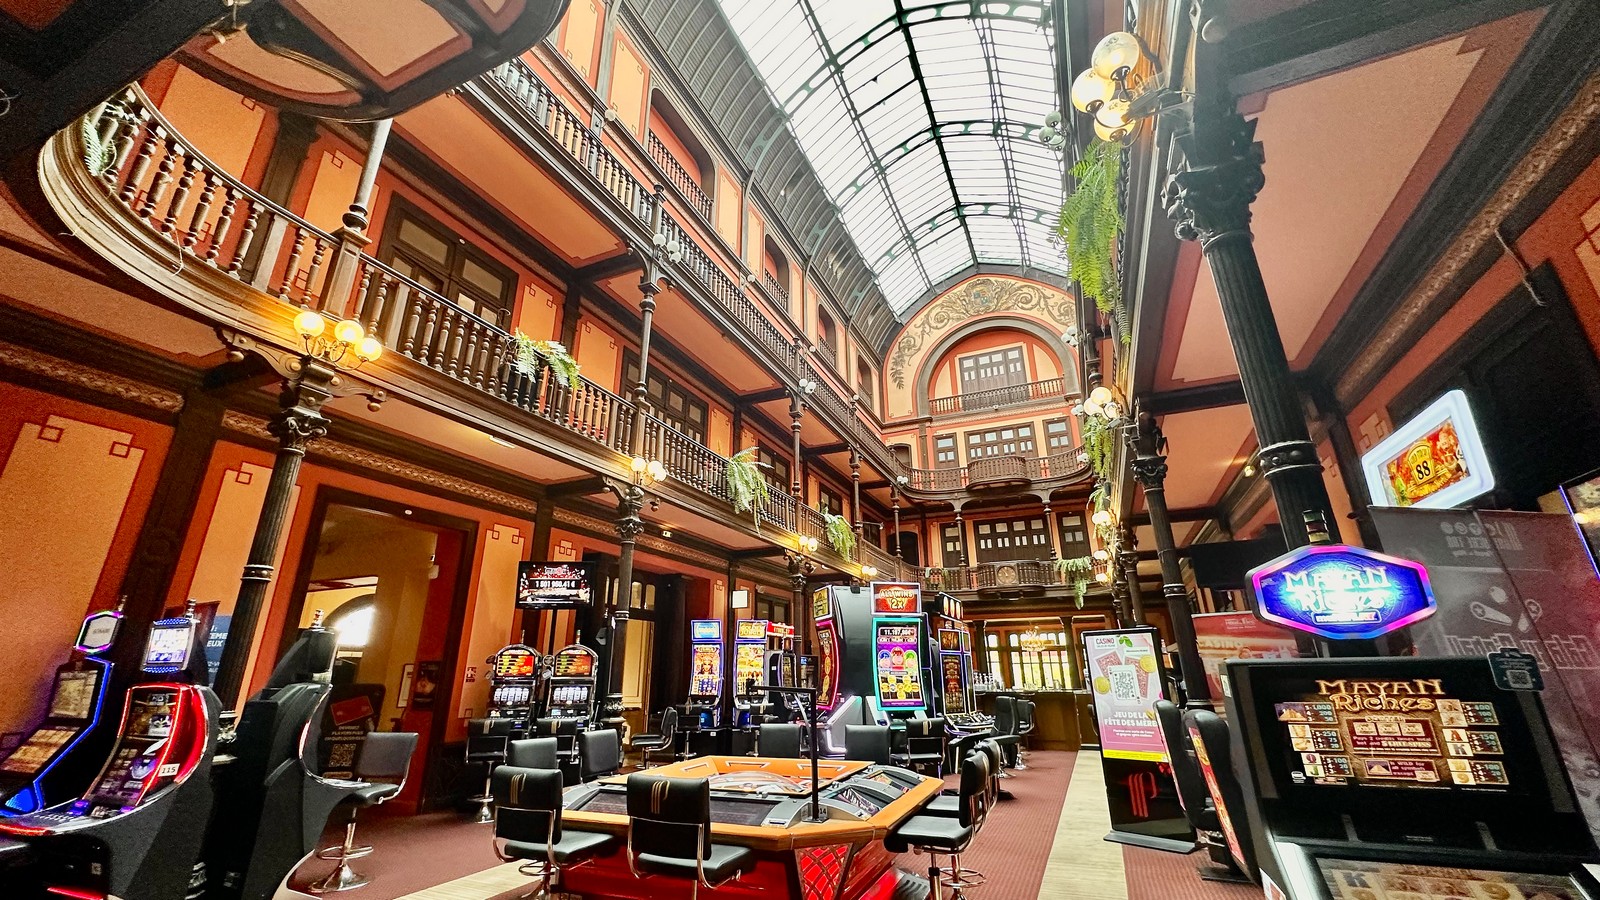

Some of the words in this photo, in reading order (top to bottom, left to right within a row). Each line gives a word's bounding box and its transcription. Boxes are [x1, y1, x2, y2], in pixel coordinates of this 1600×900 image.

[1416, 460, 1430, 480] 88
[1095, 637, 1115, 645] CASINO
[1315, 679, 1445, 695] MAYAN
[1104, 718, 1121, 726] FÊTE
[1451, 730, 1463, 741] A
[1453, 744, 1468, 755] K
[162, 766, 176, 774] 115
[1310, 765, 1319, 776] J
[1457, 773, 1470, 784] 9
